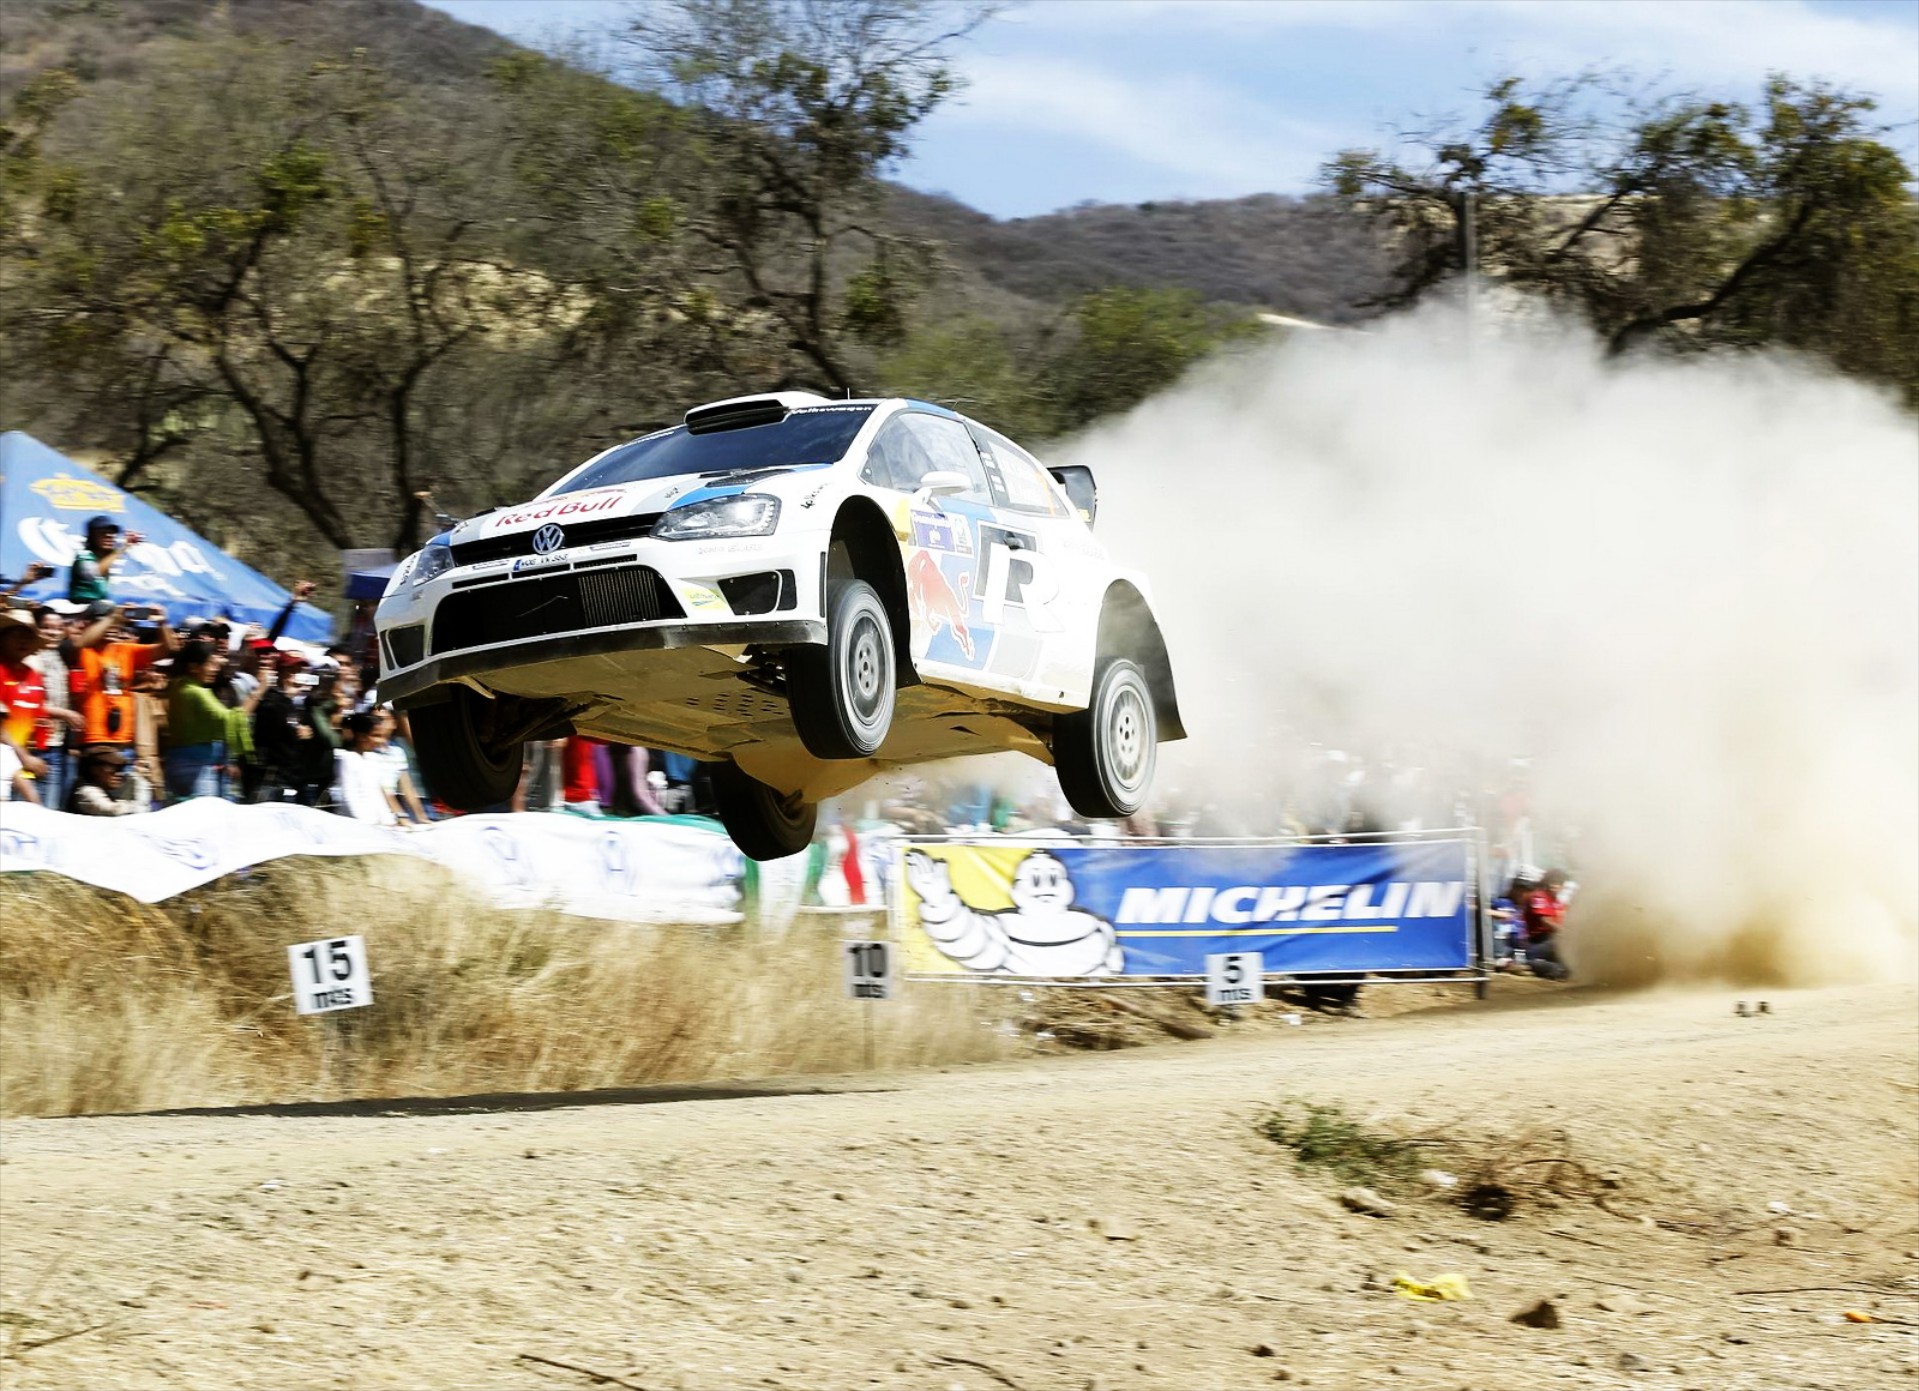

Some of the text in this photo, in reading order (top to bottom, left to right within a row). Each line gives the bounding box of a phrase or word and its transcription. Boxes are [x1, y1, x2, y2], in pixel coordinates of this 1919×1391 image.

[495, 496, 623, 527] Red Bull
[1114, 881, 1465, 924] MICHELIN
[302, 940, 352, 984] 15
[848, 943, 888, 978] 10
[1223, 956, 1245, 984] 5
